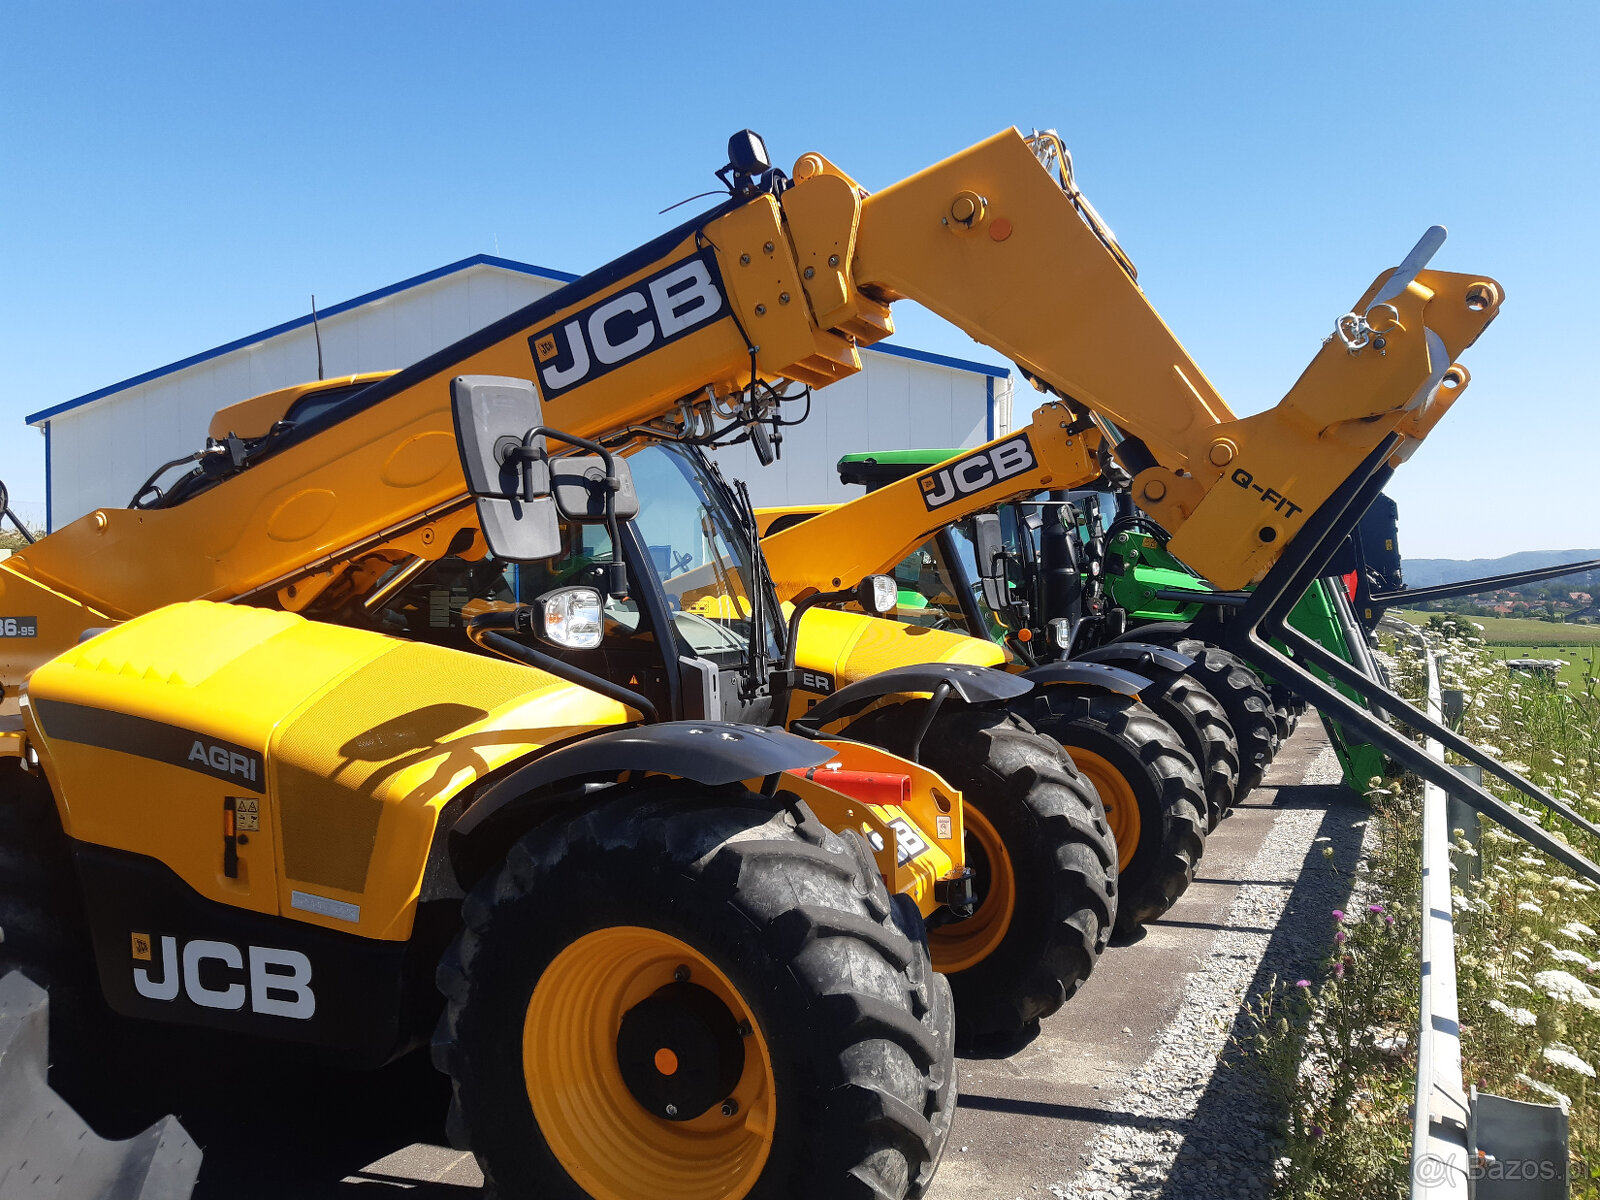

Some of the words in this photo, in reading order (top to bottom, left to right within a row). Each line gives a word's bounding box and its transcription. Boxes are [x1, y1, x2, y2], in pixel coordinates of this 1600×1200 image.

[543, 259, 722, 390] JCB
[926, 439, 1033, 506] JCB
[1231, 468, 1303, 519] Q-FIT
[188, 740, 256, 782] AGRI
[134, 935, 316, 1020] JCB
